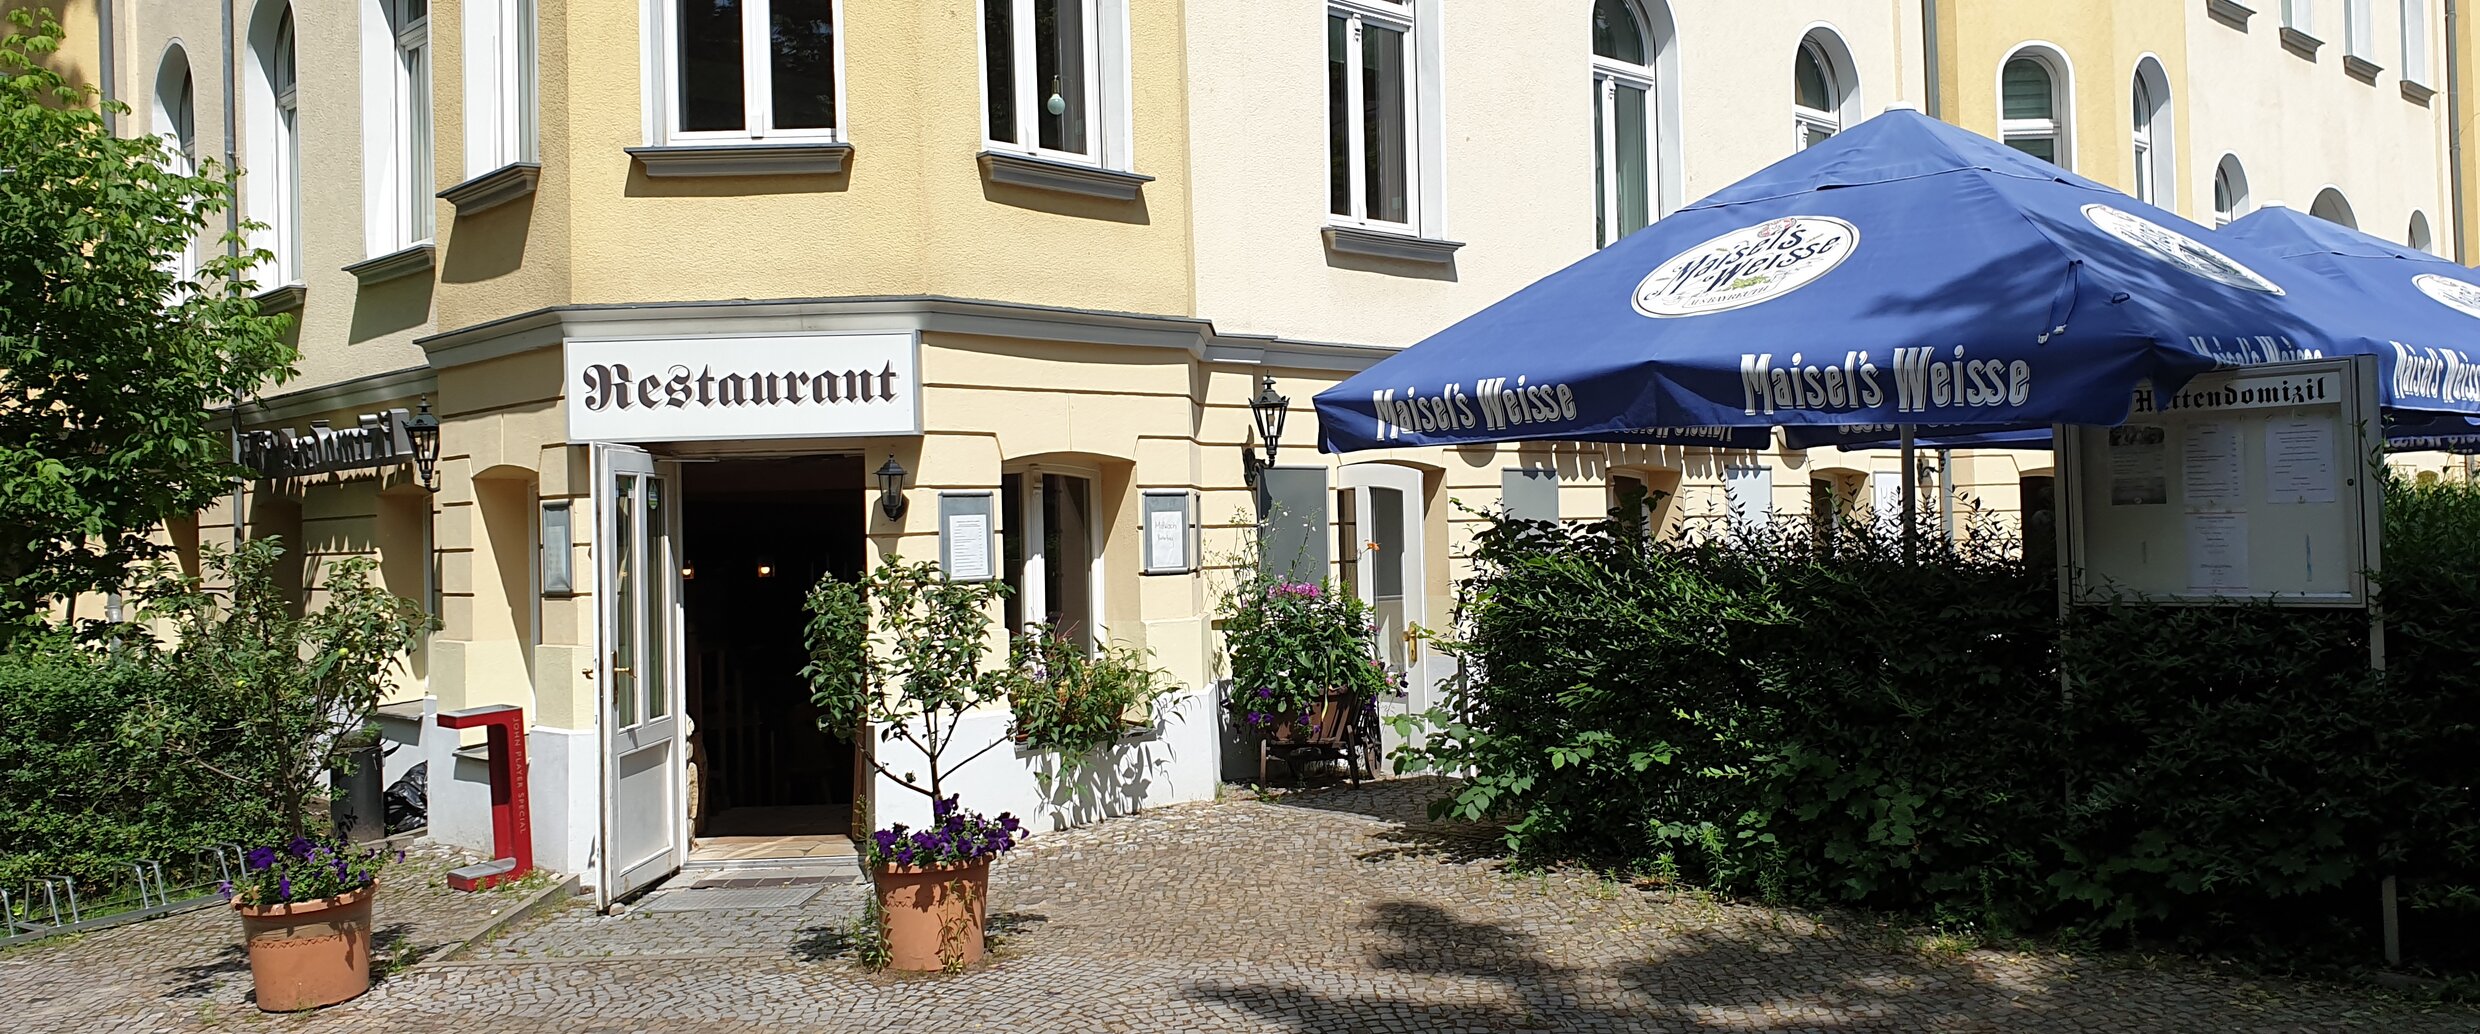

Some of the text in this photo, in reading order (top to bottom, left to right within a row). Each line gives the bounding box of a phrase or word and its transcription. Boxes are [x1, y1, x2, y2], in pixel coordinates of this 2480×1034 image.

[1644, 224, 1806, 301] Maisel's
[1702, 236, 1841, 292] Weisse
[582, 359, 899, 413] Restaurant
[1740, 344, 2030, 416] Maisel's Weisse
[2134, 376, 2326, 413] Httendomizil
[2389, 340, 2444, 399] Maisel's
[1373, 374, 1577, 442] Maisel's Weisse
[515, 751, 524, 789] PLAYER
[517, 791, 527, 834] SPECIAL
